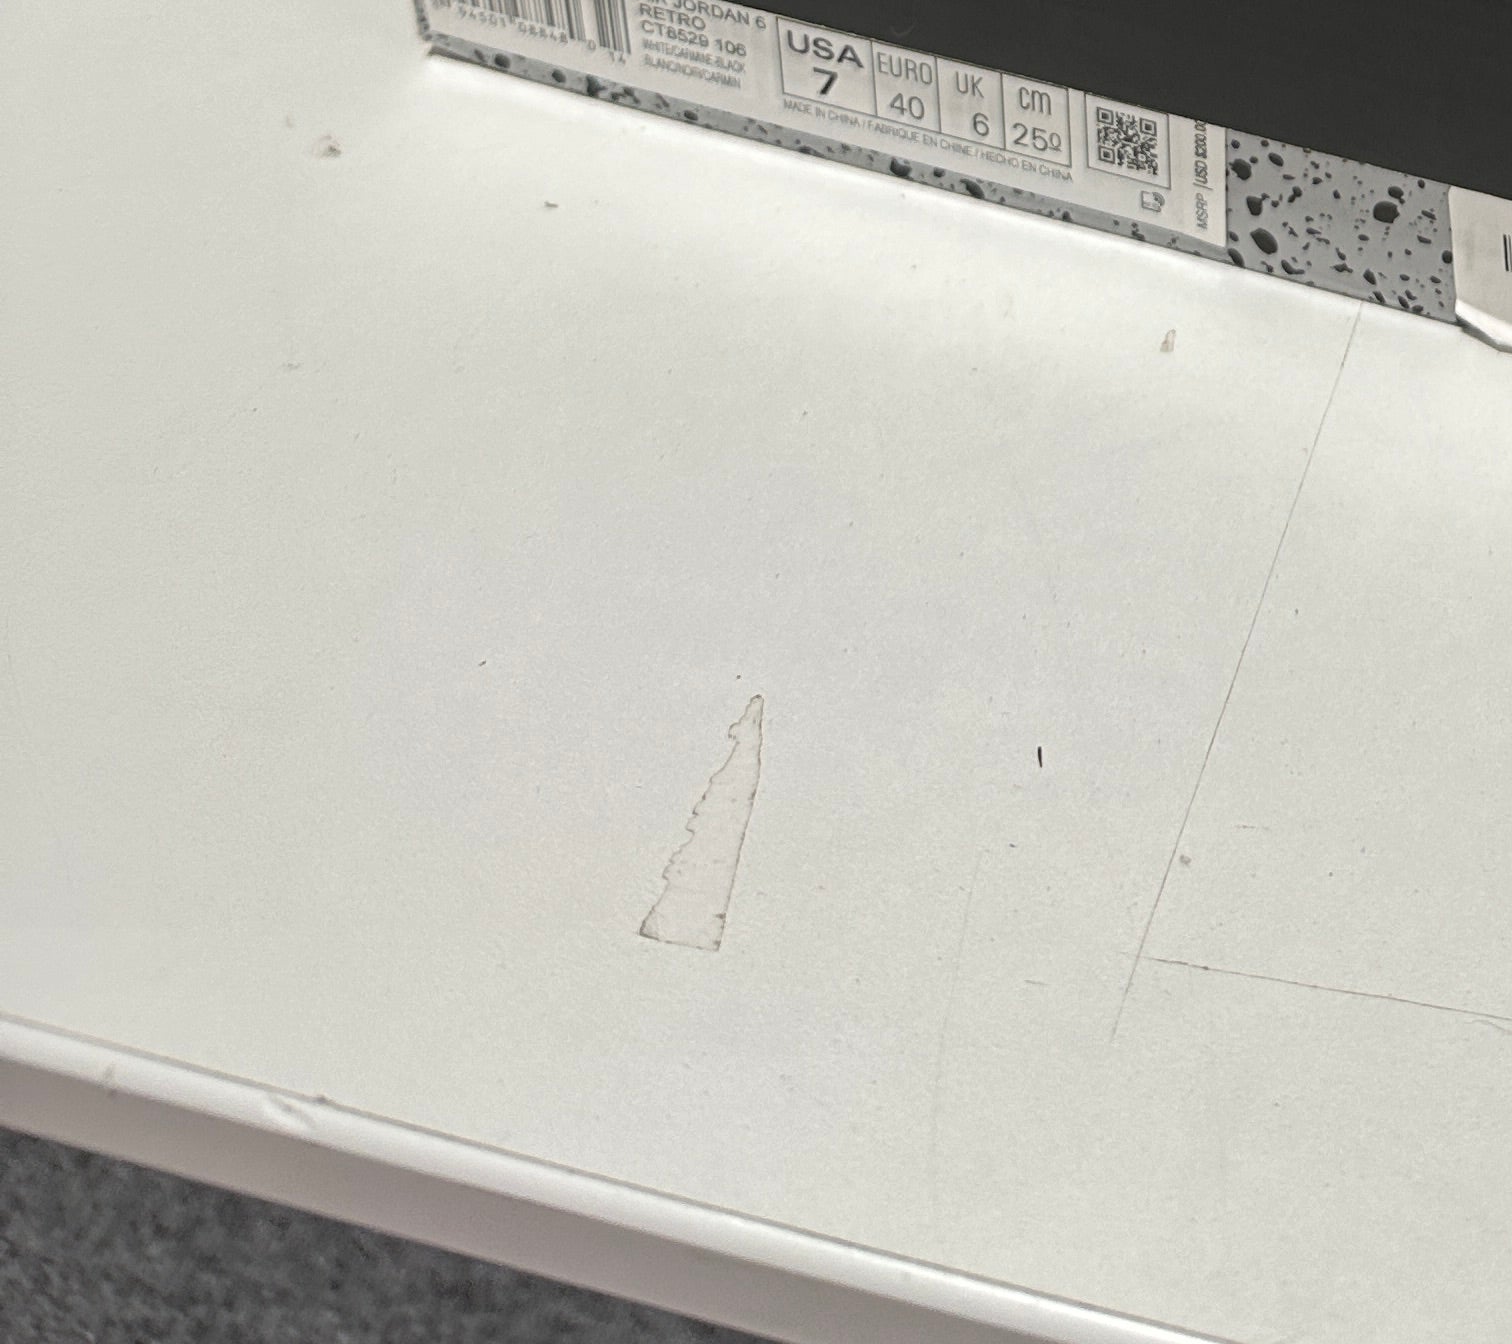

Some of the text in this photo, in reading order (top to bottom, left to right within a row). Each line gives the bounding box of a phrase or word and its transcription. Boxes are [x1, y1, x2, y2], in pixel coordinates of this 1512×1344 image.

[639, 3, 706, 30] RETRO
[755, 15, 767, 29] 6
[641, 20, 747, 56] CT8529 106
[786, 30, 864, 68] USA
[813, 66, 838, 95] 7
[876, 51, 933, 85] EURO
[955, 72, 984, 98] UK
[889, 93, 925, 120] 40
[1018, 86, 1052, 115] cm
[973, 112, 990, 137] 6
